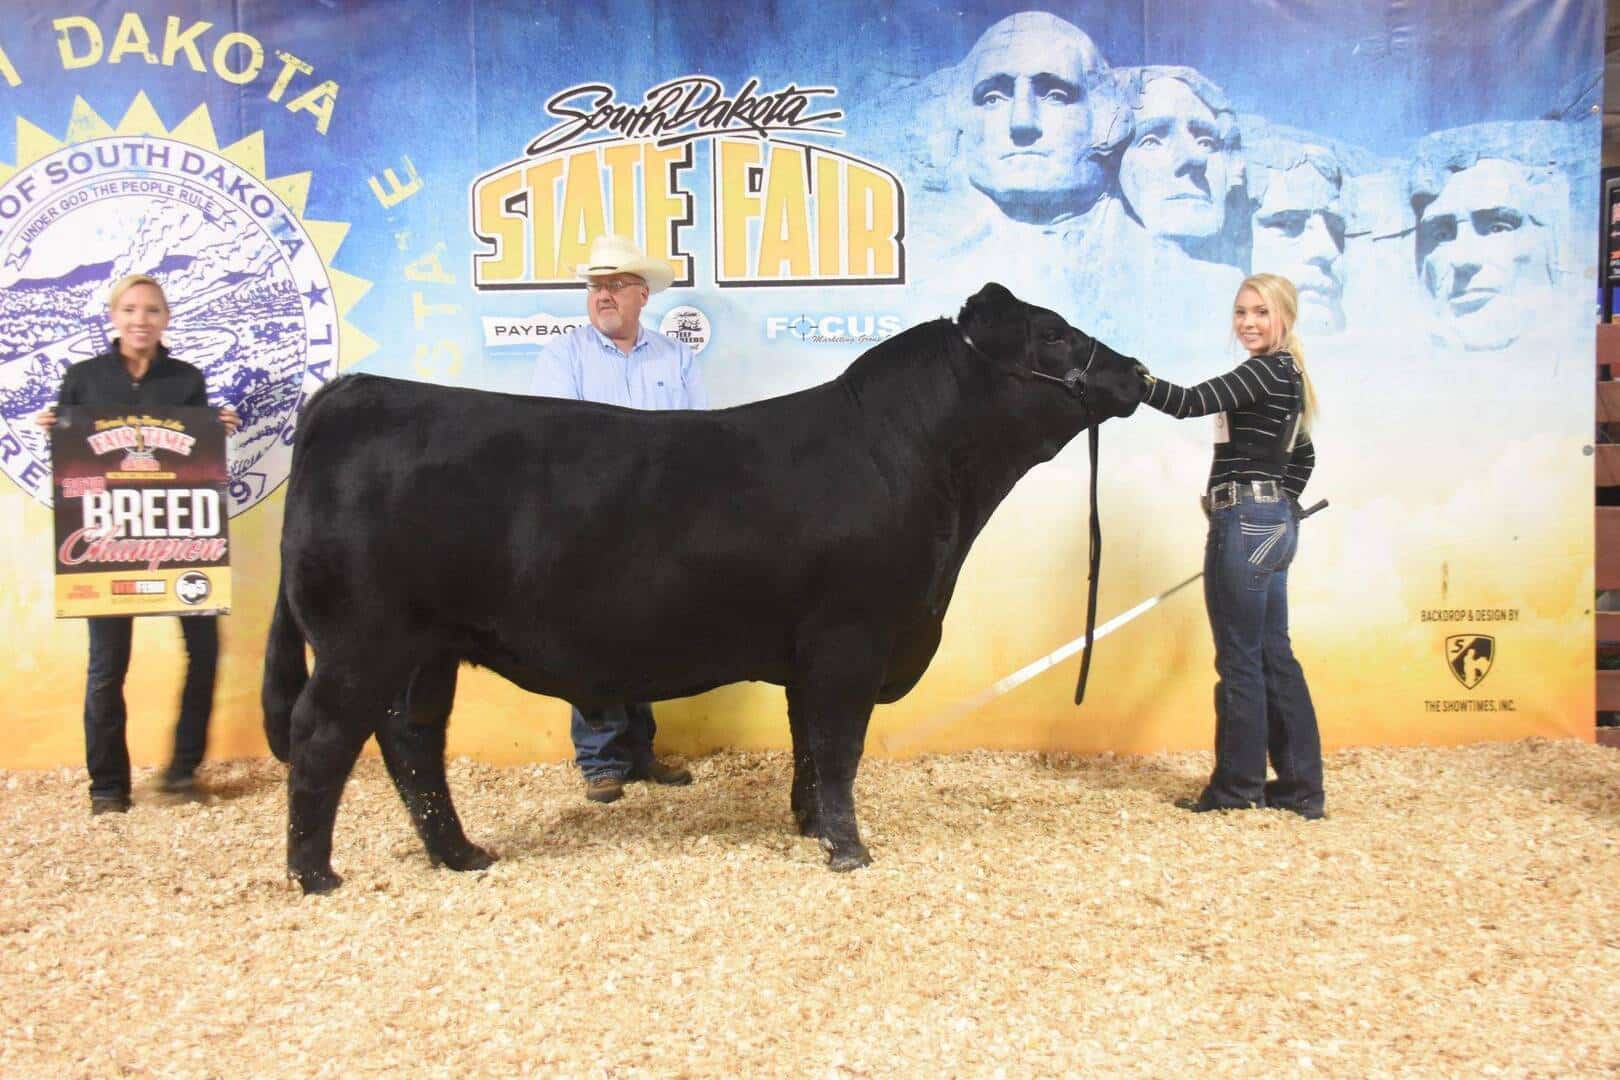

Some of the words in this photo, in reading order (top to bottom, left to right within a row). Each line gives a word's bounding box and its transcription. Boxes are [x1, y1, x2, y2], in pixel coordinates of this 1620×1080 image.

[52, 12, 341, 135] DAKOTA
[526, 84, 678, 156] South
[647, 78, 842, 146] Dakota
[0, 174, 36, 219] OF
[45, 143, 170, 185] SOUTH
[180, 150, 304, 262] DAKOTA
[20, 207, 59, 244] UNDER
[59, 191, 89, 211] GOD
[92, 182, 119, 198] THE
[121, 181, 175, 196] PEOPLE
[179, 189, 215, 213] RULE
[472, 137, 694, 289] STATE
[715, 137, 906, 288] FAIR
[766, 314, 901, 339] FOCUS
[82, 489, 220, 537] BREED
[58, 525, 227, 573] Champion
[1421, 609, 1465, 622] BACKDROP
[1475, 609, 1507, 622] DESIGN
[1509, 609, 1519, 621] BY
[1424, 700, 1440, 712] THE
[1441, 700, 1498, 713] SHOWTIMES,
[1498, 699, 1517, 712] INC.
